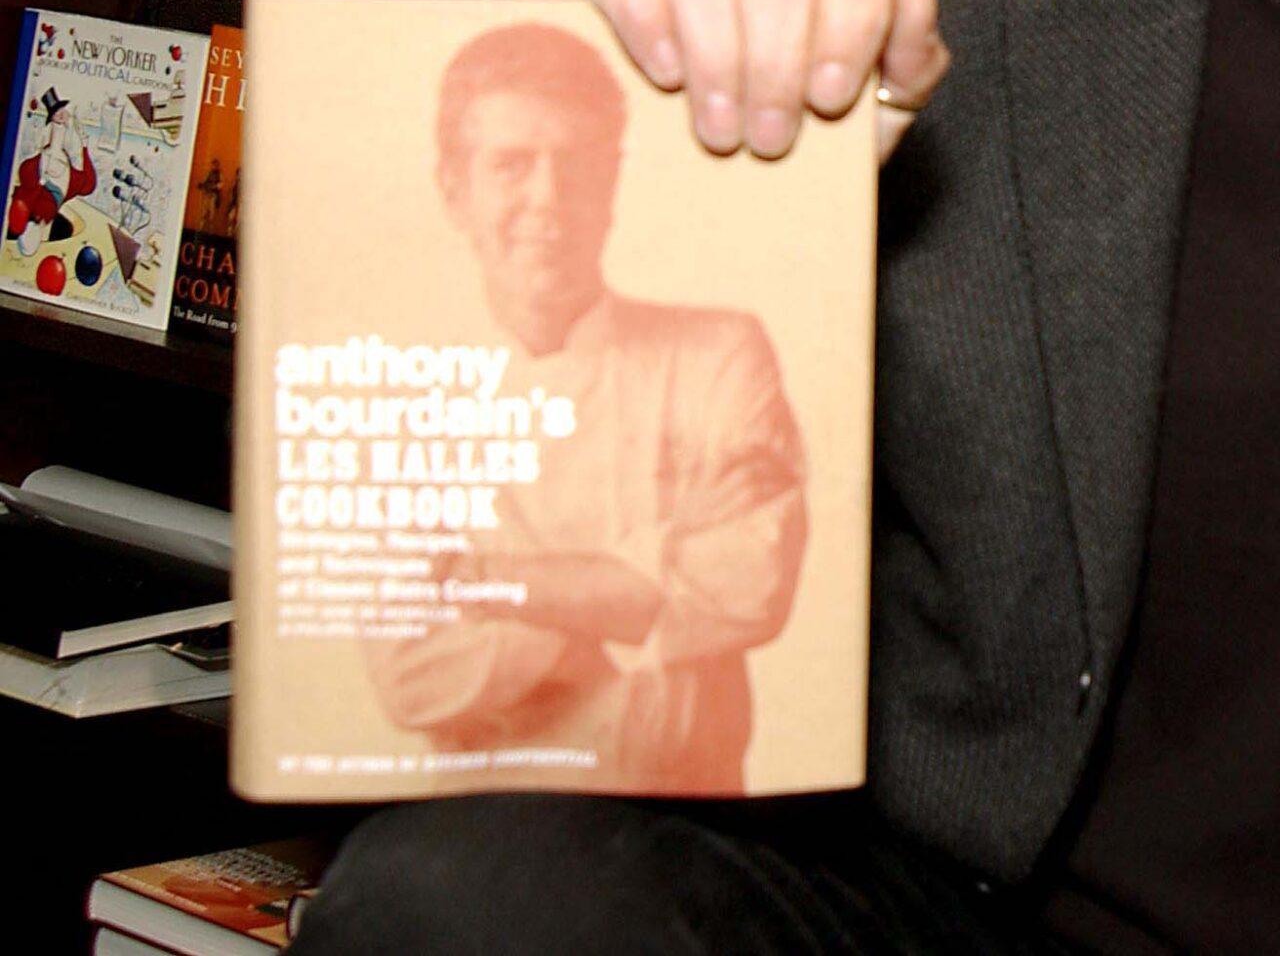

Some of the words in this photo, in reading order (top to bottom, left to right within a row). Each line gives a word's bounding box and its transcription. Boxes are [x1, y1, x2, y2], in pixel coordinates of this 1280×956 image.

[70, 58, 131, 85] POLITICAL
[71, 39, 103, 60] NEW
[103, 45, 158, 74] YORKER
[175, 275, 240, 311] COM
[187, 308, 207, 325] Road
[207, 312, 229, 331] from
[275, 334, 510, 394] anthony
[275, 387, 576, 437] bourdain's
[277, 438, 360, 482] LES
[369, 438, 541, 484] HALLES
[275, 484, 501, 530] COOKBOOK
